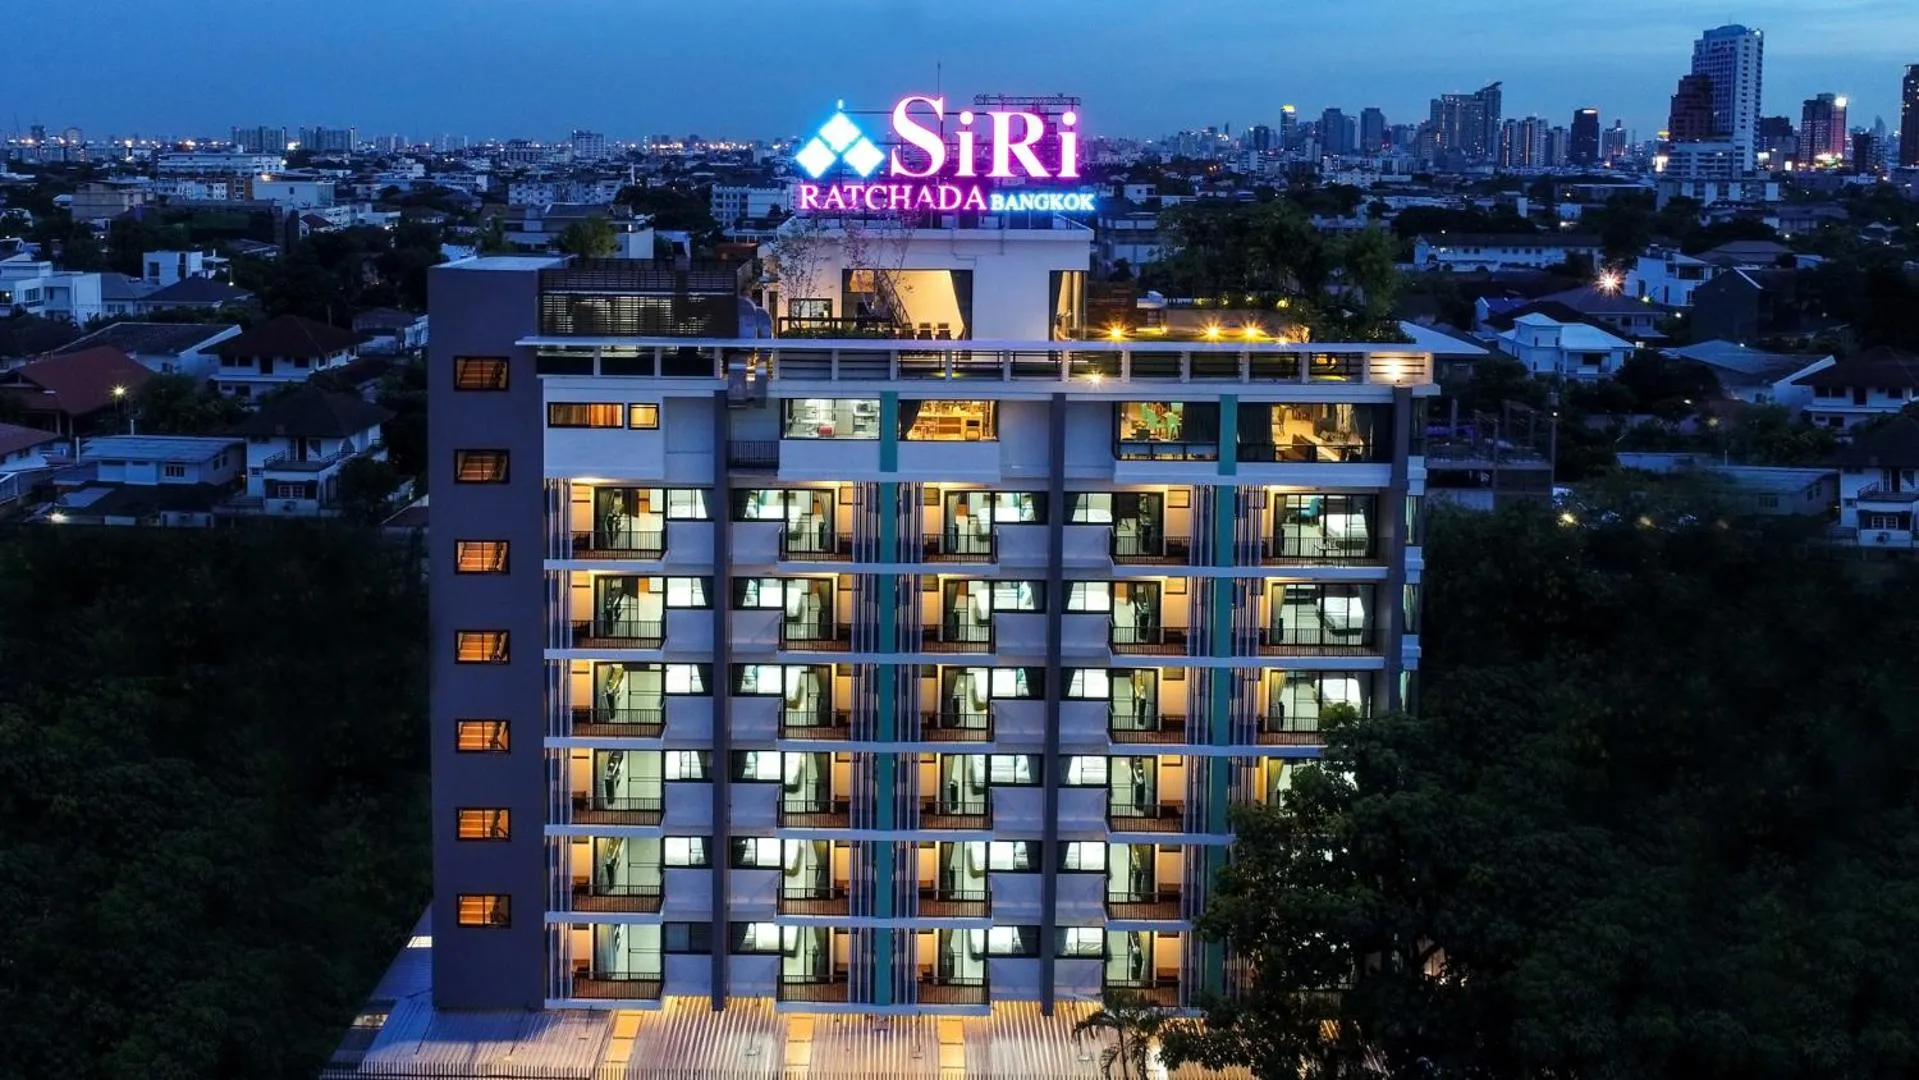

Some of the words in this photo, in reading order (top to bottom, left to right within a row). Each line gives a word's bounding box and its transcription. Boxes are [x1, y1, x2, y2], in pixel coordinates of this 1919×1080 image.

[890, 96, 1080, 178] SiRi
[799, 184, 988, 210] RATCHADA
[990, 193, 1096, 211] BANGKOK
